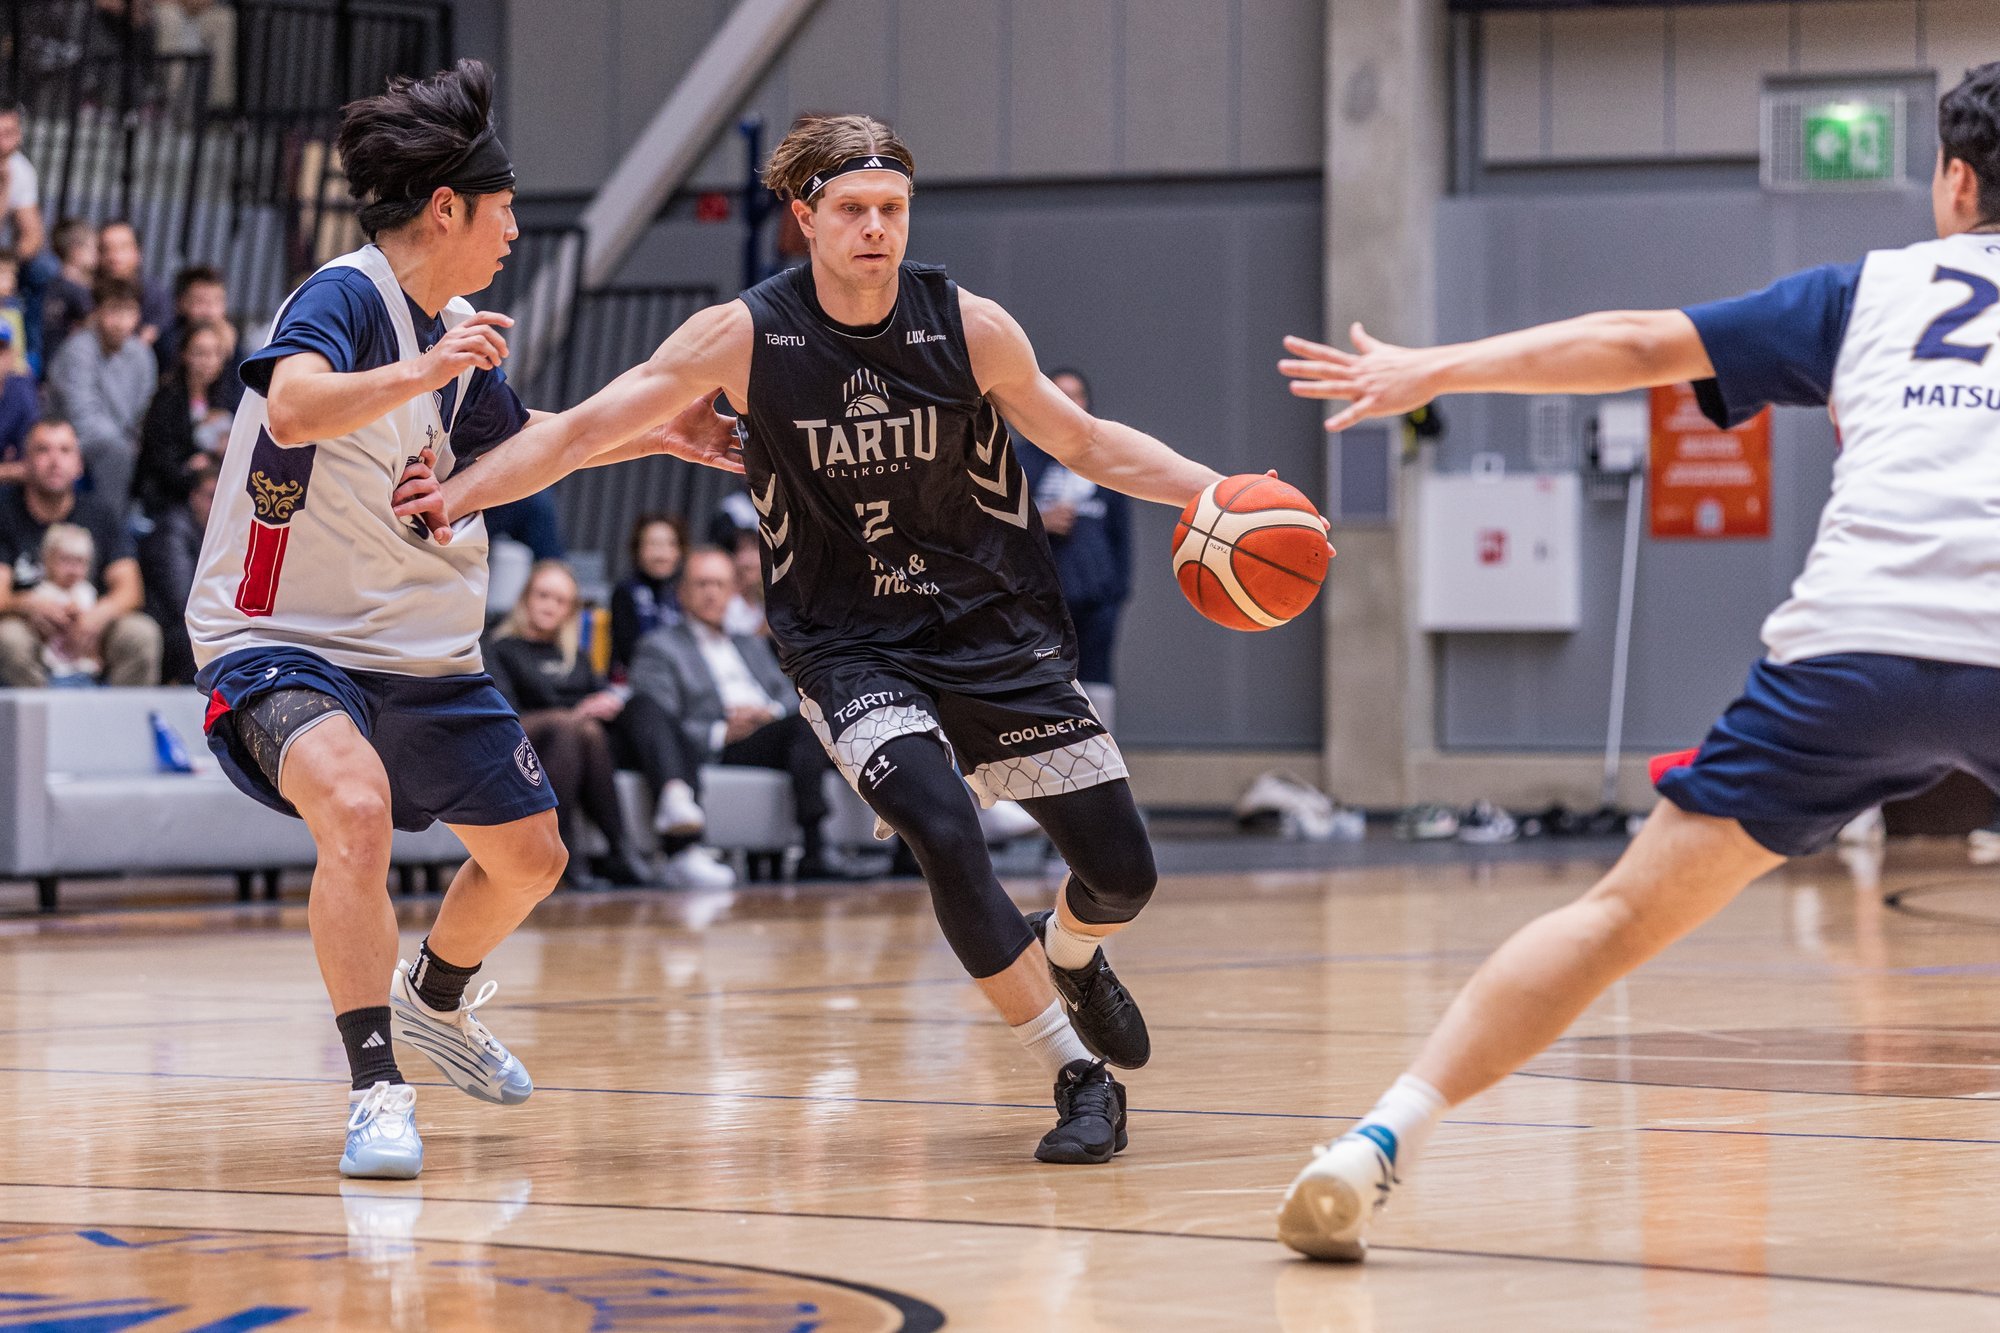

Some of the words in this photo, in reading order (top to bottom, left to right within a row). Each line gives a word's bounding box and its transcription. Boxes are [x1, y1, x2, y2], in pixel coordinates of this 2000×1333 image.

[1910, 264, 2000, 367] 2
[906, 329, 926, 345] LUX
[792, 405, 938, 471] TARTU
[826, 462, 911, 479] ÜLIKOOL
[998, 718, 1076, 746] COOLBET
